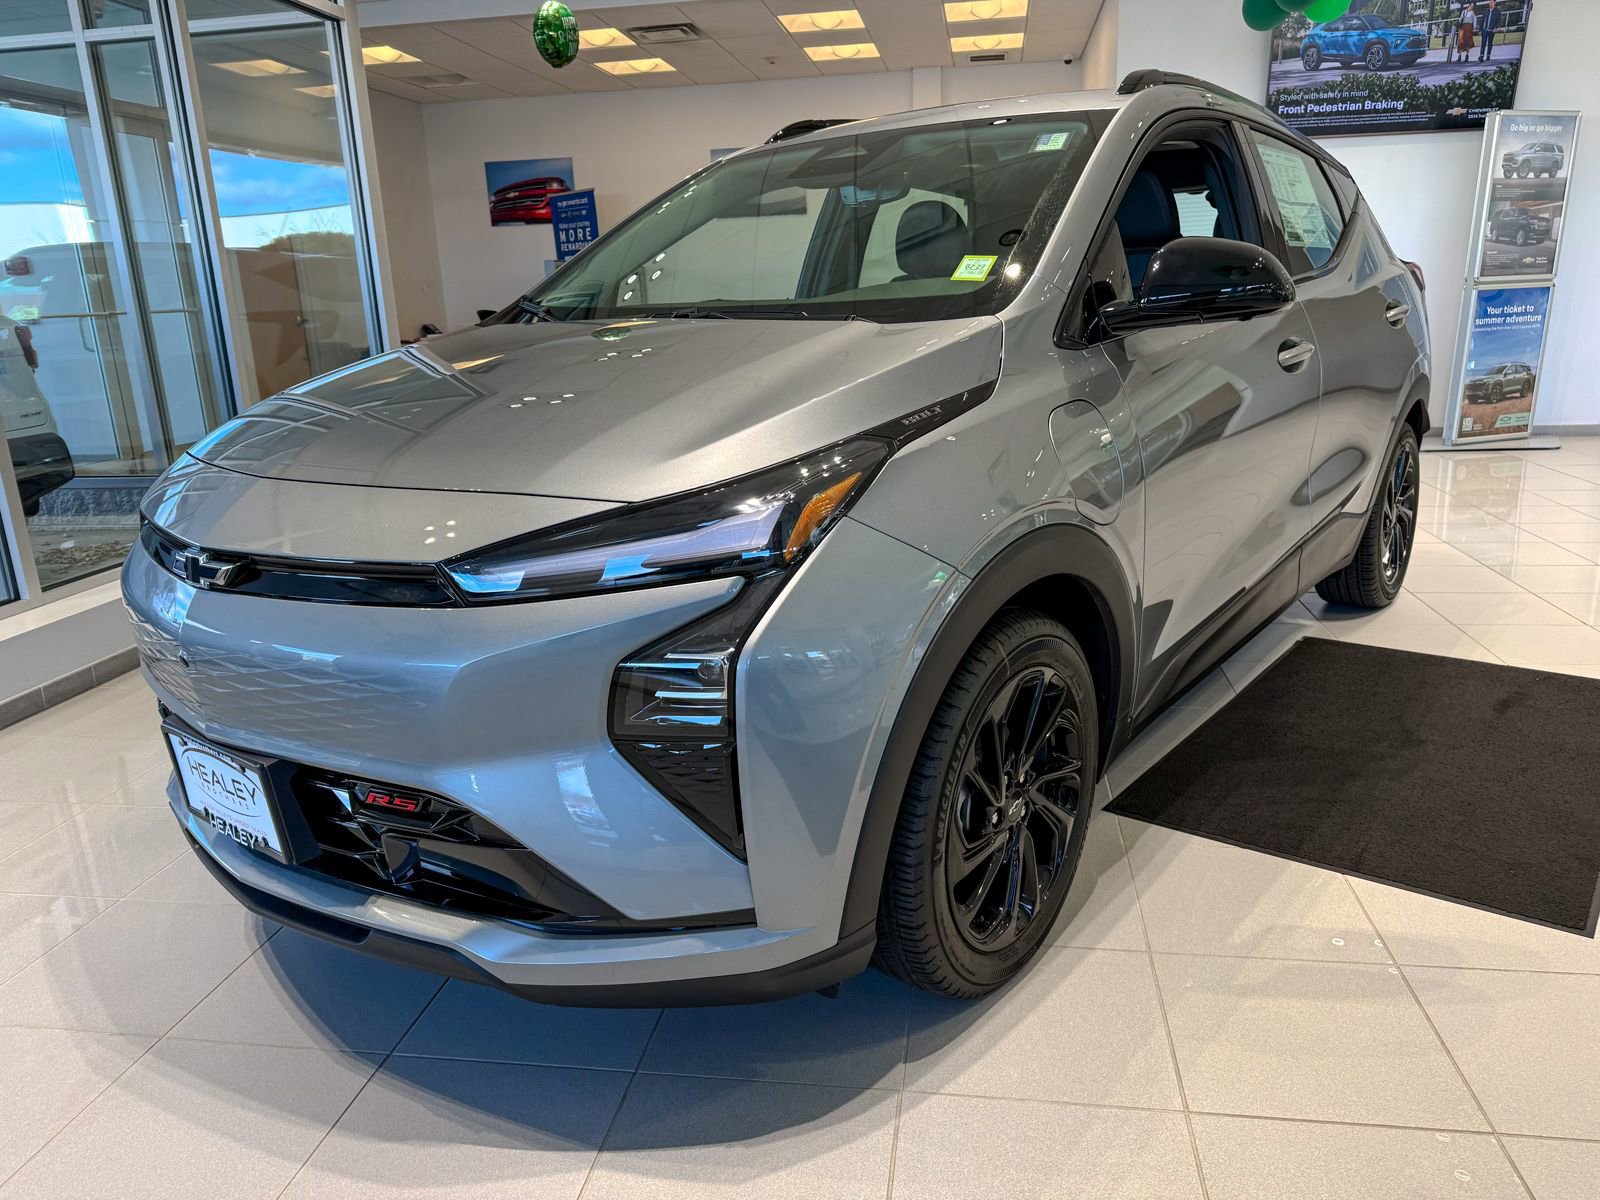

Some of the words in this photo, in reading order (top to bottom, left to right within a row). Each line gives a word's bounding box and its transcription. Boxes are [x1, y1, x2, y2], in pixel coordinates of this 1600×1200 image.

[1280, 93, 1301, 101] Styled
[1303, 92, 1319, 100] with
[1319, 91, 1341, 99] safety
[1278, 105, 1305, 114] Front
[1307, 102, 1362, 113] Pedestrian
[1511, 123, 1519, 131] Go
[1519, 123, 1529, 132] big
[1545, 123, 1563, 132] bigger
[560, 228, 592, 242] MORE
[1486, 306, 1503, 315] Your
[1504, 304, 1526, 314] ticket
[1526, 304, 1534, 313] to
[1475, 316, 1505, 325] summer
[1505, 314, 1541, 324] adventure
[187, 756, 256, 805] HEALEY
[937, 733, 967, 838] MICHELIN
[367, 792, 417, 811] RS
[209, 815, 259, 849] HEALEY
